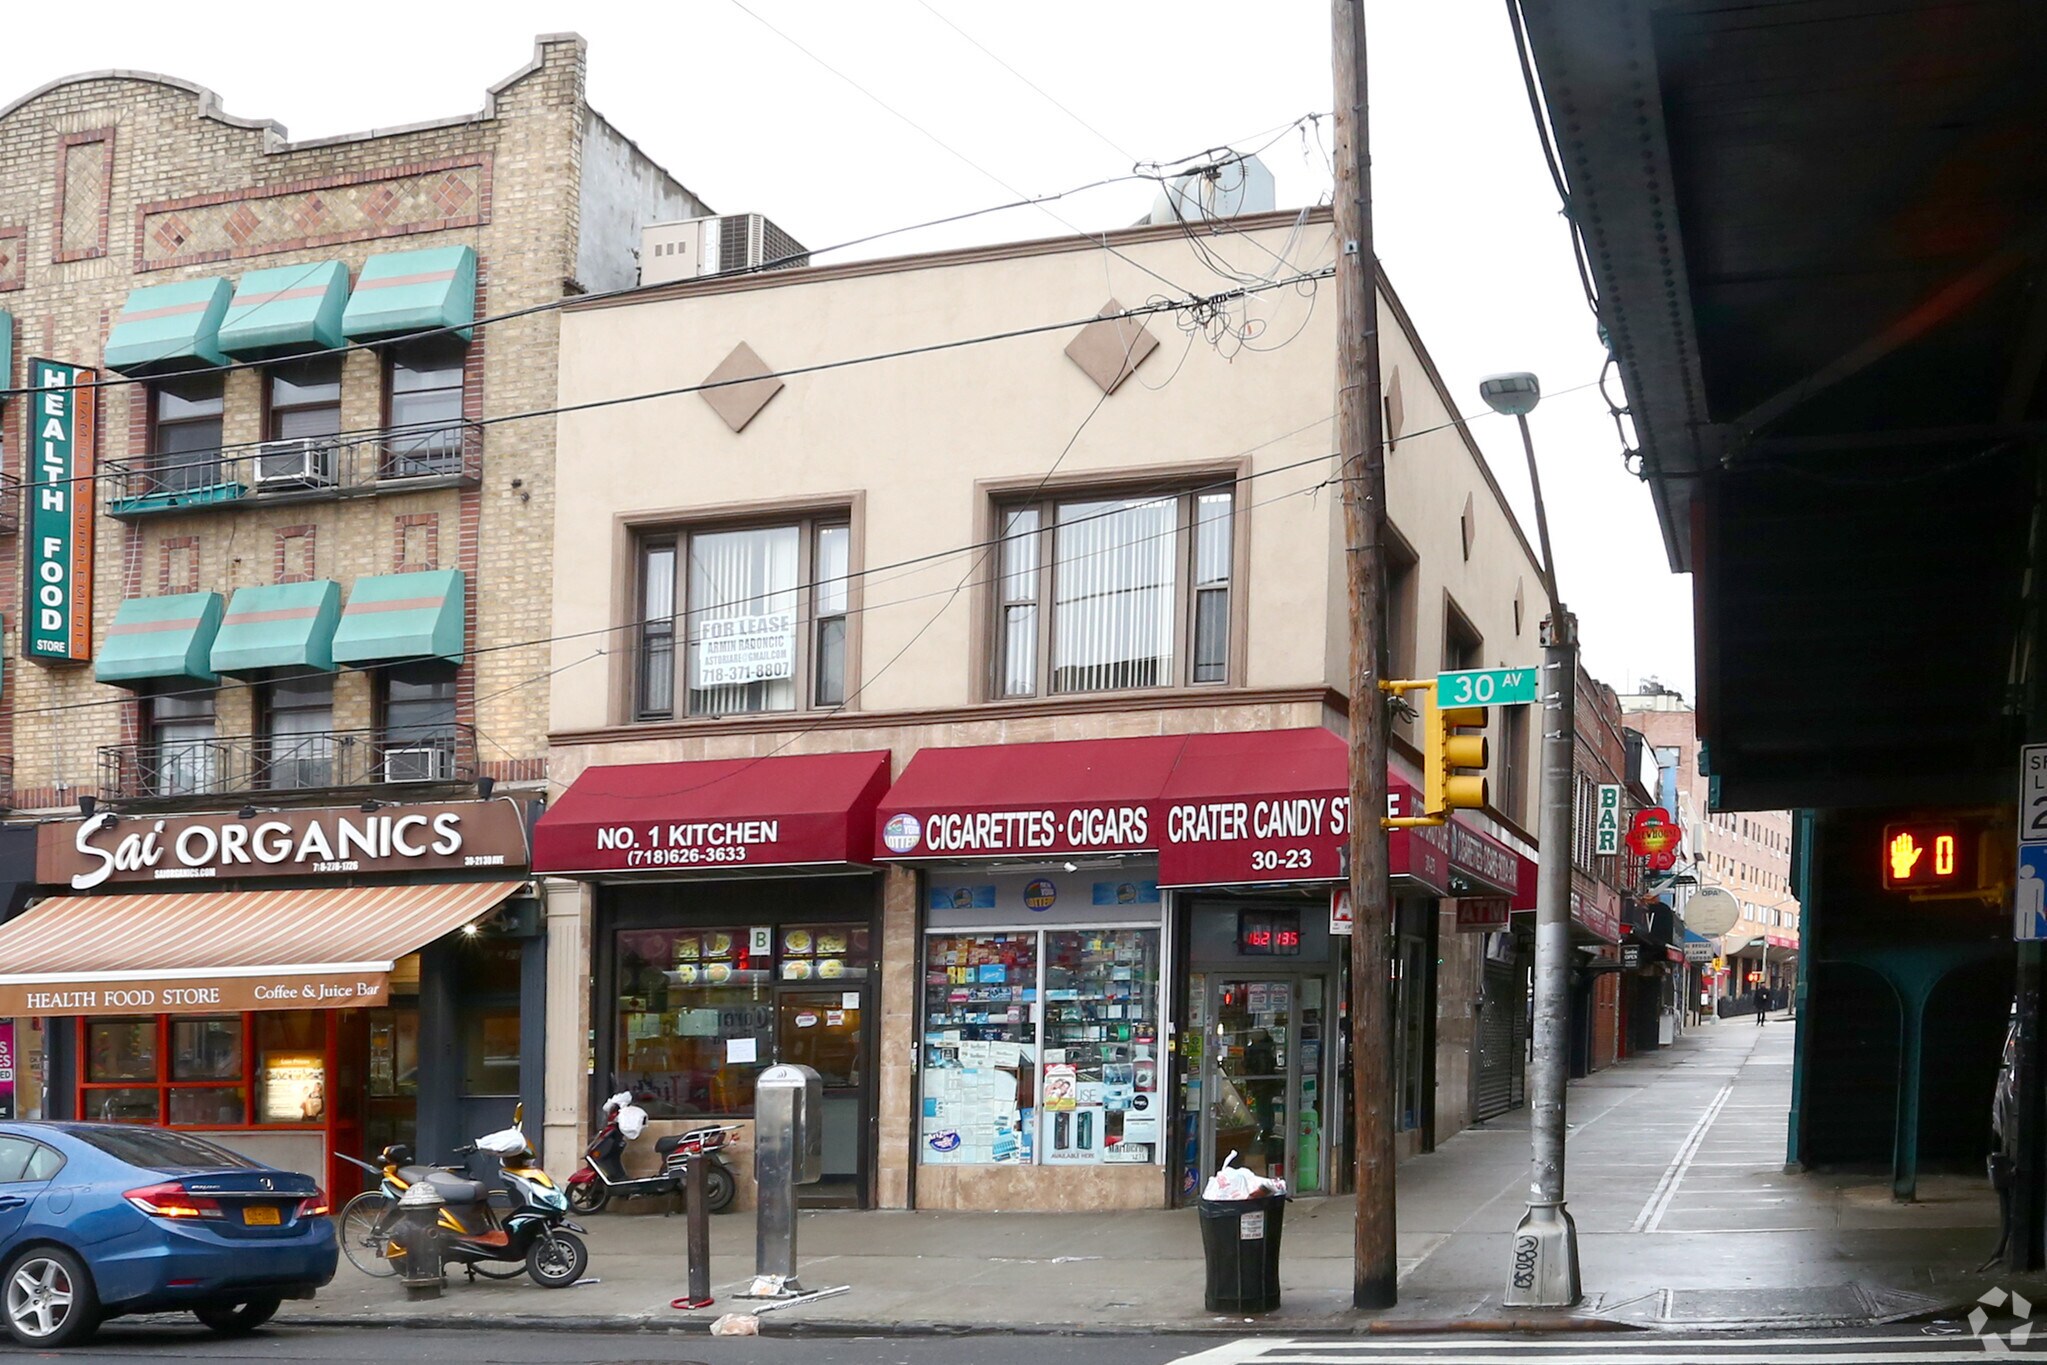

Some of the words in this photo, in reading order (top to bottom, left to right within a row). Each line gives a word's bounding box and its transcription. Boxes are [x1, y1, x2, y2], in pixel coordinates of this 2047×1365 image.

[42, 368, 66, 511] HEALTH
[40, 536, 63, 630] FOOD
[75, 503, 87, 654] SUPPLEMENTS
[702, 621, 735, 640] FOR
[739, 615, 790, 635] LEASE
[36, 639, 66, 653] STORE
[707, 640, 737, 653] ARMIN
[738, 635, 784, 650] RADONCIC
[702, 662, 790, 683] 718-371-8807
[1453, 674, 1495, 703] 30
[1502, 672, 1522, 688] AV
[925, 811, 1056, 851] CIGARETTES
[1066, 806, 1148, 846] CIGARS
[1167, 802, 1249, 843] CRATER
[1253, 798, 1326, 839] CANDY
[1330, 793, 1400, 835] STE
[1599, 788, 1617, 851] BAR
[597, 827, 639, 850] NO.
[648, 826, 659, 848] 1
[668, 821, 778, 848] KITCHEN
[71, 812, 165, 889] Sai
[175, 812, 462, 867] ORGANICS
[627, 846, 746, 866] (718)626-3633
[1251, 848, 1312, 871] 30-23
[154, 867, 216, 879] SAIORGANICS.COM
[1459, 902, 1507, 924] ATM
[755, 931, 767, 948] B
[1248, 931, 1270, 946] 162
[26, 992, 97, 1009] HEALTH
[104, 989, 155, 1007] FOOD
[162, 987, 221, 1005] STORE
[254, 984, 298, 1000] Coffee
[301, 984, 316, 998] &
[318, 982, 353, 998] Juice
[356, 982, 380, 996] Bar
